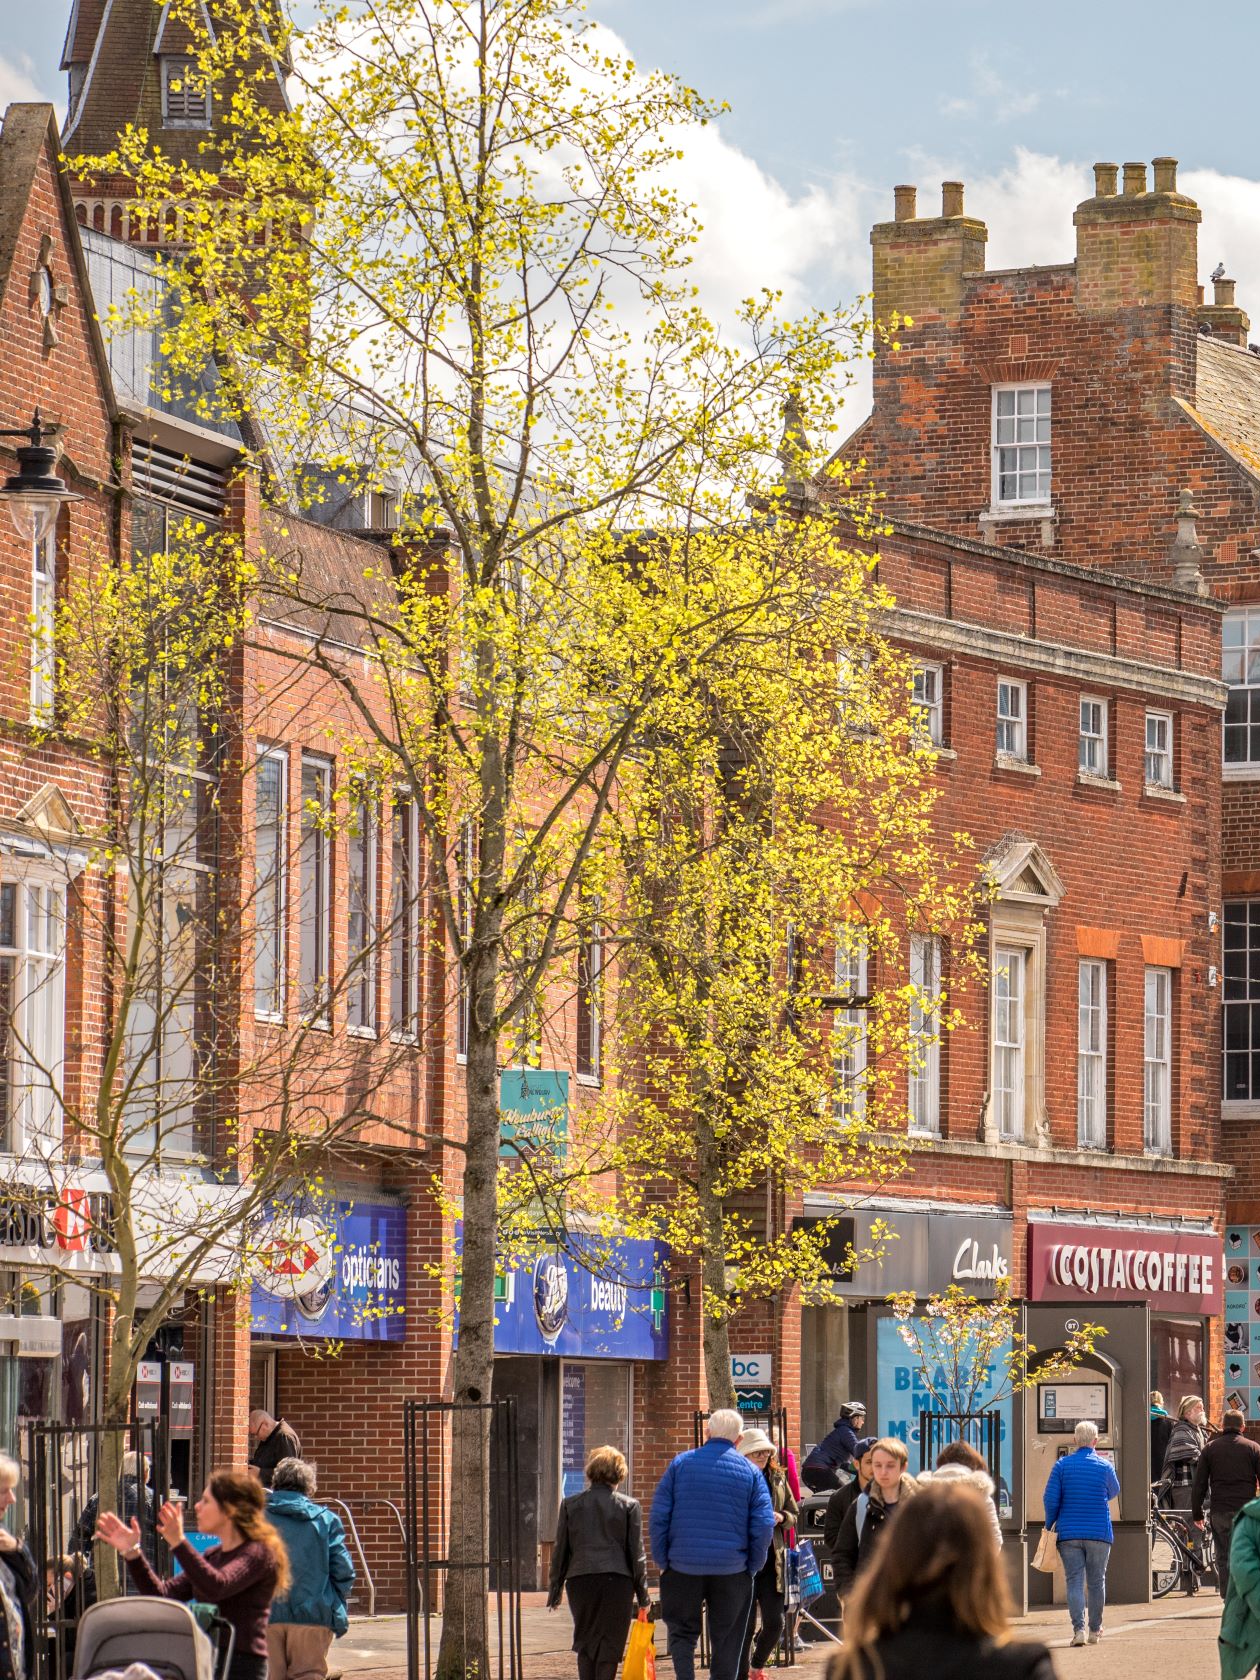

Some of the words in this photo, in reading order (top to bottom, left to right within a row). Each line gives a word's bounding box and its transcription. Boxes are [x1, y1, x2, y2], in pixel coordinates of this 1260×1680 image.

[342, 1245, 400, 1295] opticians
[952, 1238, 1008, 1280] Clarks
[1054, 1244, 1126, 1294] COSTA
[1128, 1249, 1214, 1295] COFFEE
[591, 1273, 627, 1322] beauty
[894, 1366, 926, 1391] BE
[932, 1365, 950, 1390] A
